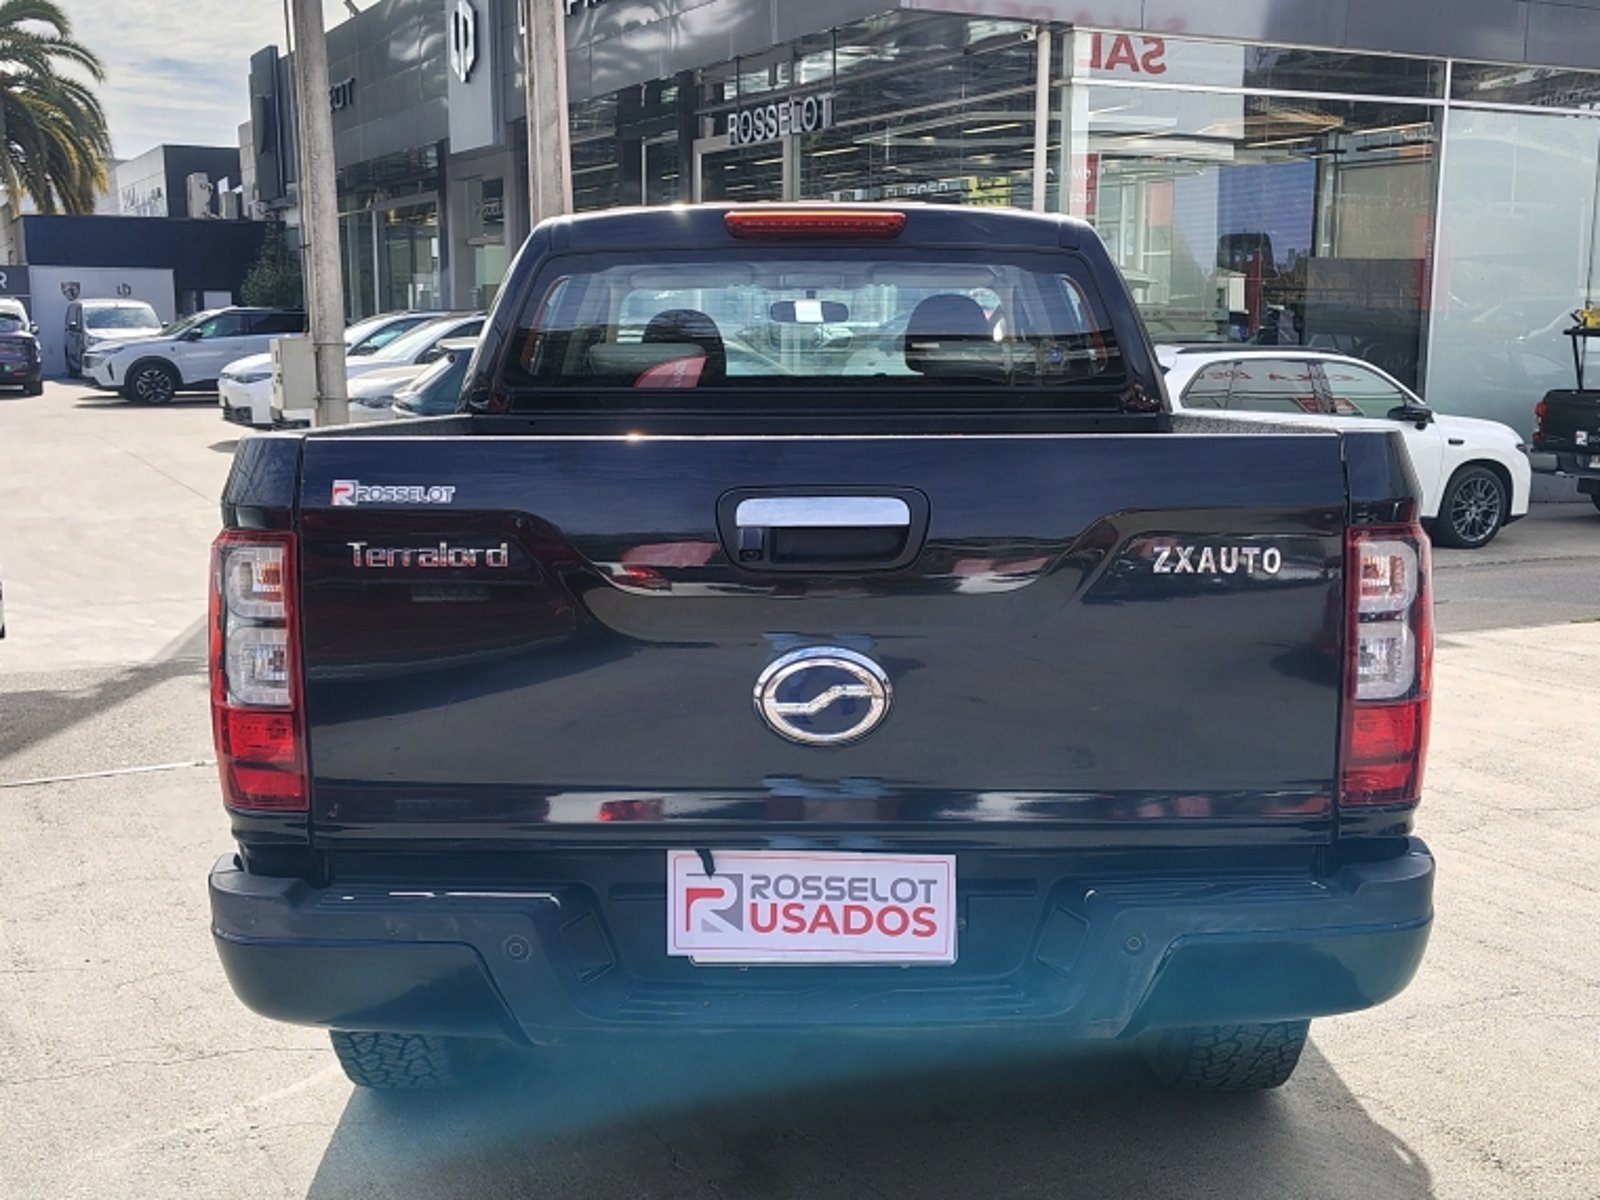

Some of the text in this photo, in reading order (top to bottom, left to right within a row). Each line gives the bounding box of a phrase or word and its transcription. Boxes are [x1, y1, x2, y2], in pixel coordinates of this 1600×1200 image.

[727, 93, 833, 145] ROSSELOT
[357, 486, 456, 503] ROSSELOT
[347, 541, 509, 567] Terralord
[1152, 546, 1282, 574] ZXAUTO
[750, 874, 938, 904] ROSSELOT
[750, 903, 938, 938] USADOS
